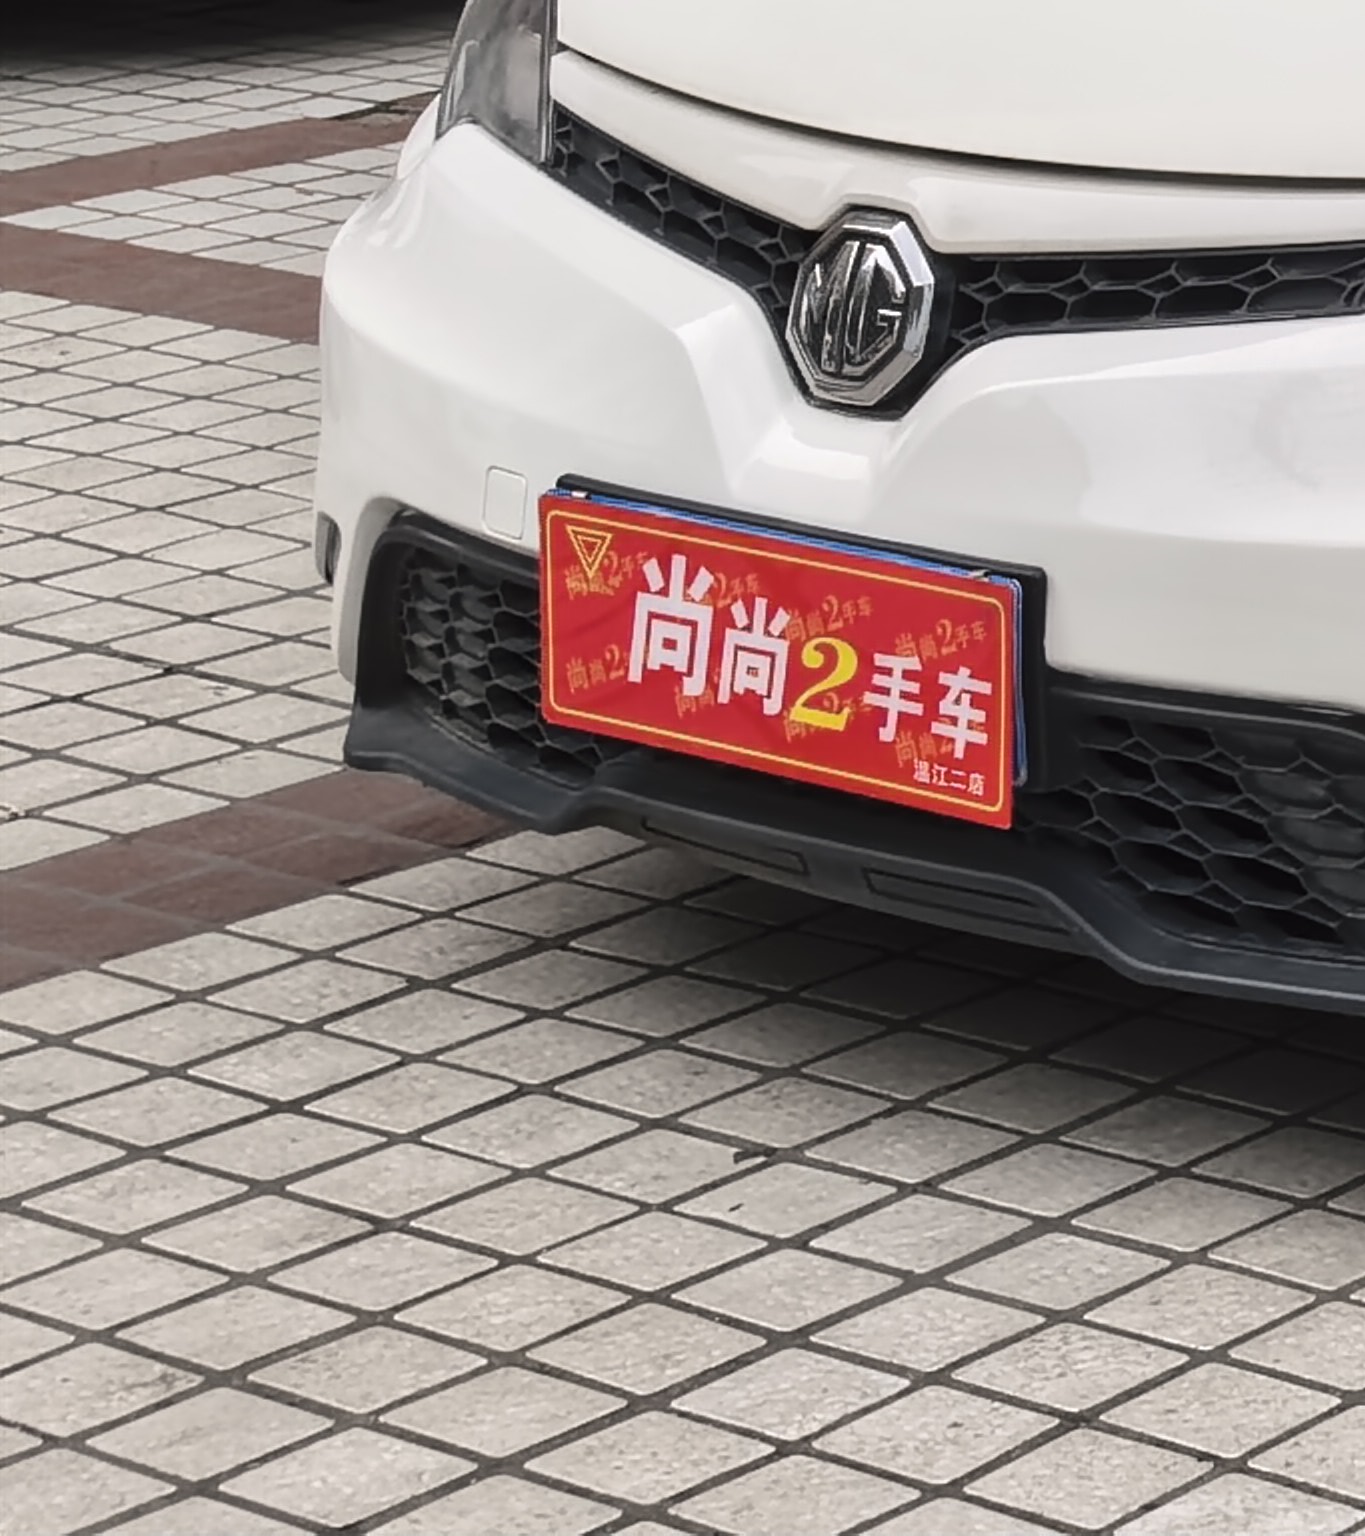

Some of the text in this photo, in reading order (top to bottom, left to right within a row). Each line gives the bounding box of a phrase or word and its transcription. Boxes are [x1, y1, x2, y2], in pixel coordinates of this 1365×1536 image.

[627, 553, 994, 761] 尚尚2手车
[912, 758, 985, 796] 温江二店
